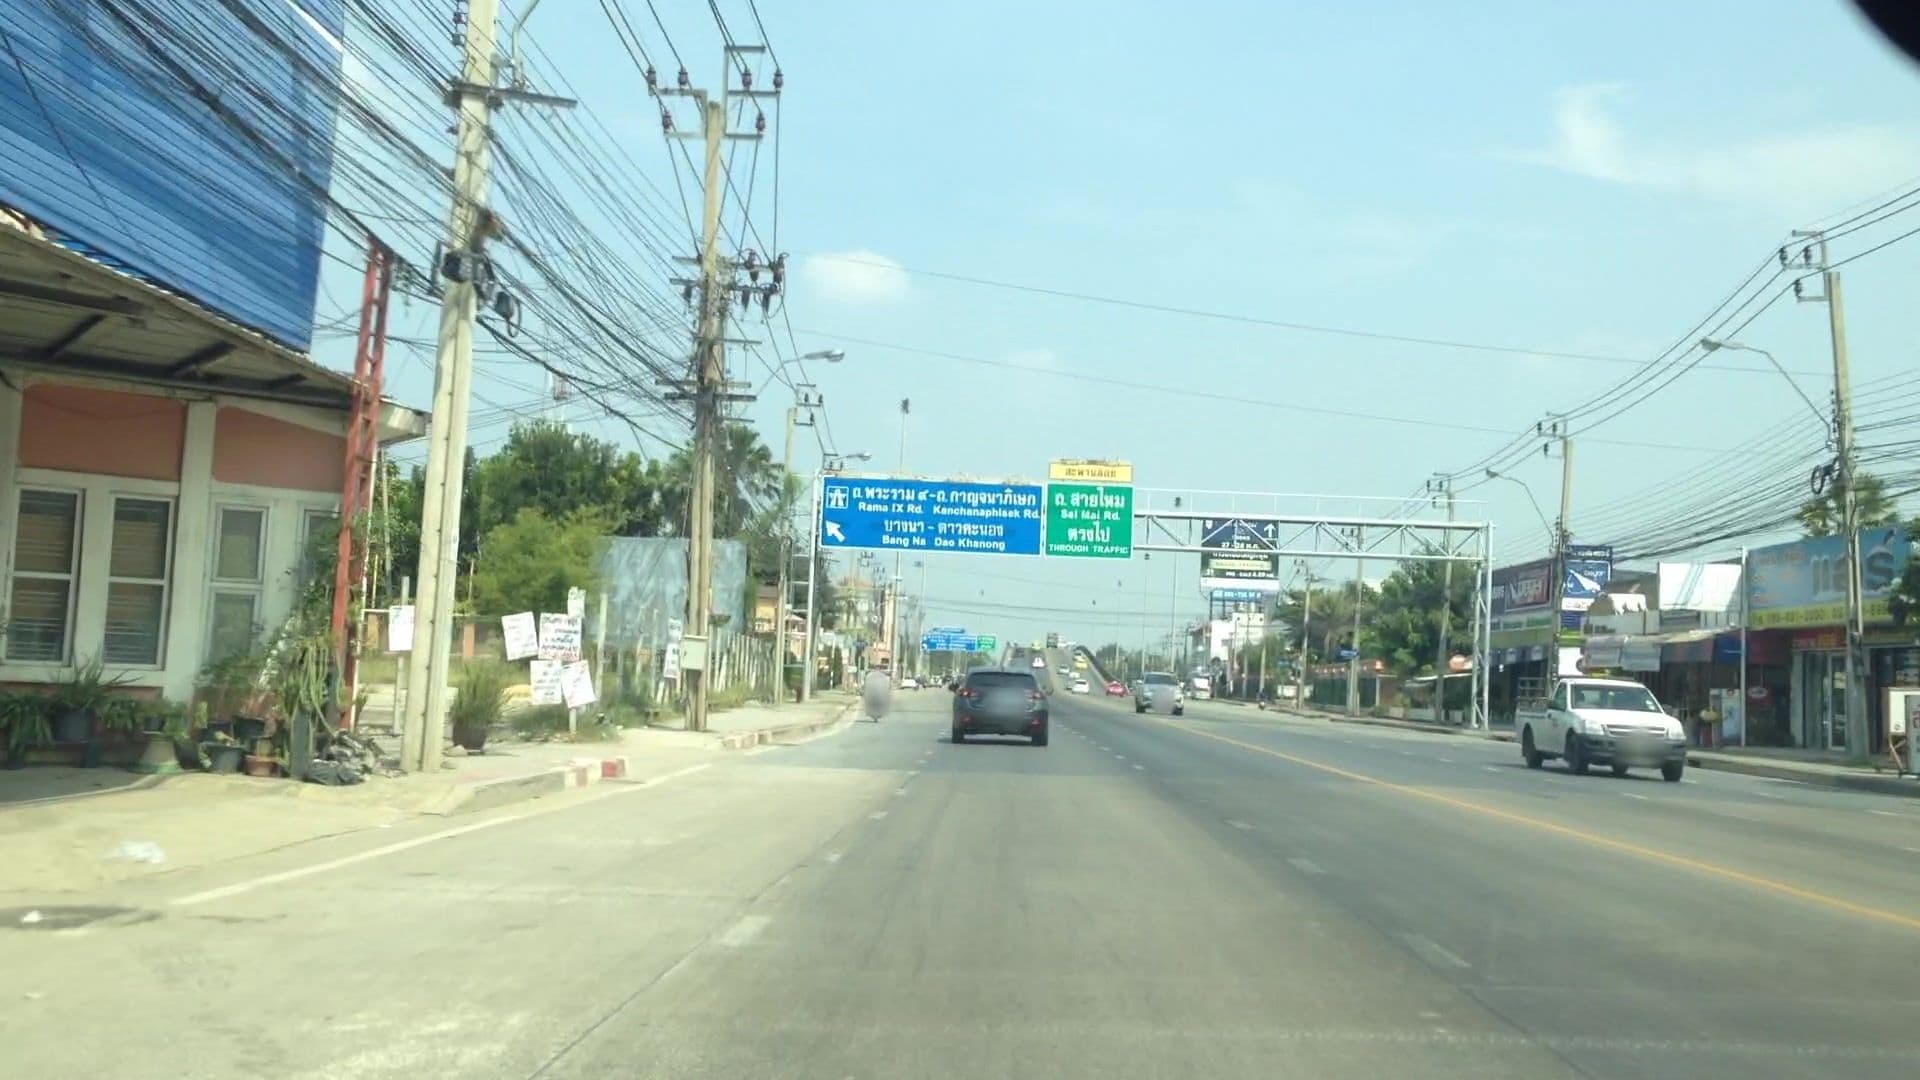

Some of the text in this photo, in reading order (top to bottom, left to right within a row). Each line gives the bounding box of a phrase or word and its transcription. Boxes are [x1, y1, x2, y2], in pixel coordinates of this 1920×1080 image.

[859, 502, 888, 513] Rama
[892, 503, 904, 513] IX
[1060, 509, 1078, 519] Sai
[1081, 510, 1100, 520] Mai
[884, 519, 925, 533] บางนา
[1067, 520, 1111, 543] ตรงไป
[882, 534, 1006, 551] Bang Na Dao Khanong
[1048, 543, 1129, 553] THROUGH TRAFFIC
